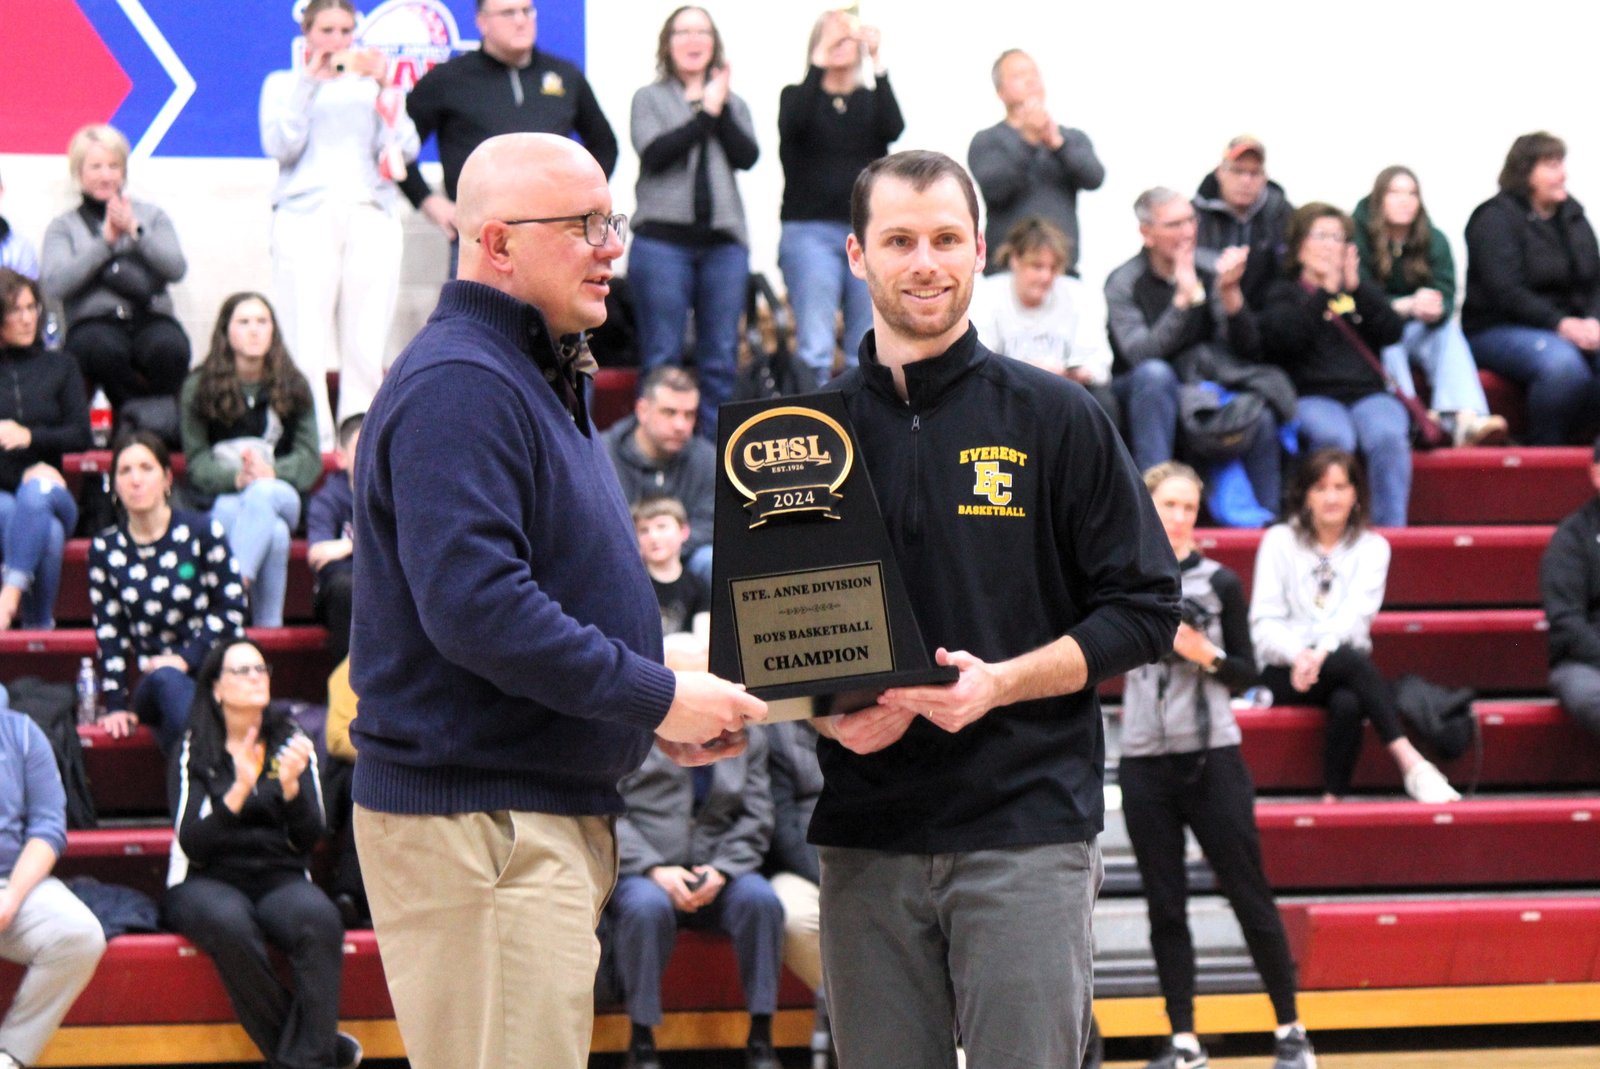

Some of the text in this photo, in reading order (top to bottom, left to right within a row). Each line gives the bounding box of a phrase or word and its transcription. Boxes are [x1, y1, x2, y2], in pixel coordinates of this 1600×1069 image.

[743, 435, 830, 468] CHSL
[959, 446, 1028, 467] EVEREST
[973, 461, 1013, 506] EC
[773, 491, 815, 508] 2024
[958, 505, 1026, 517] BASKETBALL
[741, 576, 873, 602] STE. ANNE DIVISION
[753, 620, 873, 644] BOYS BASKETBALL
[763, 645, 870, 671] CHAMPION
